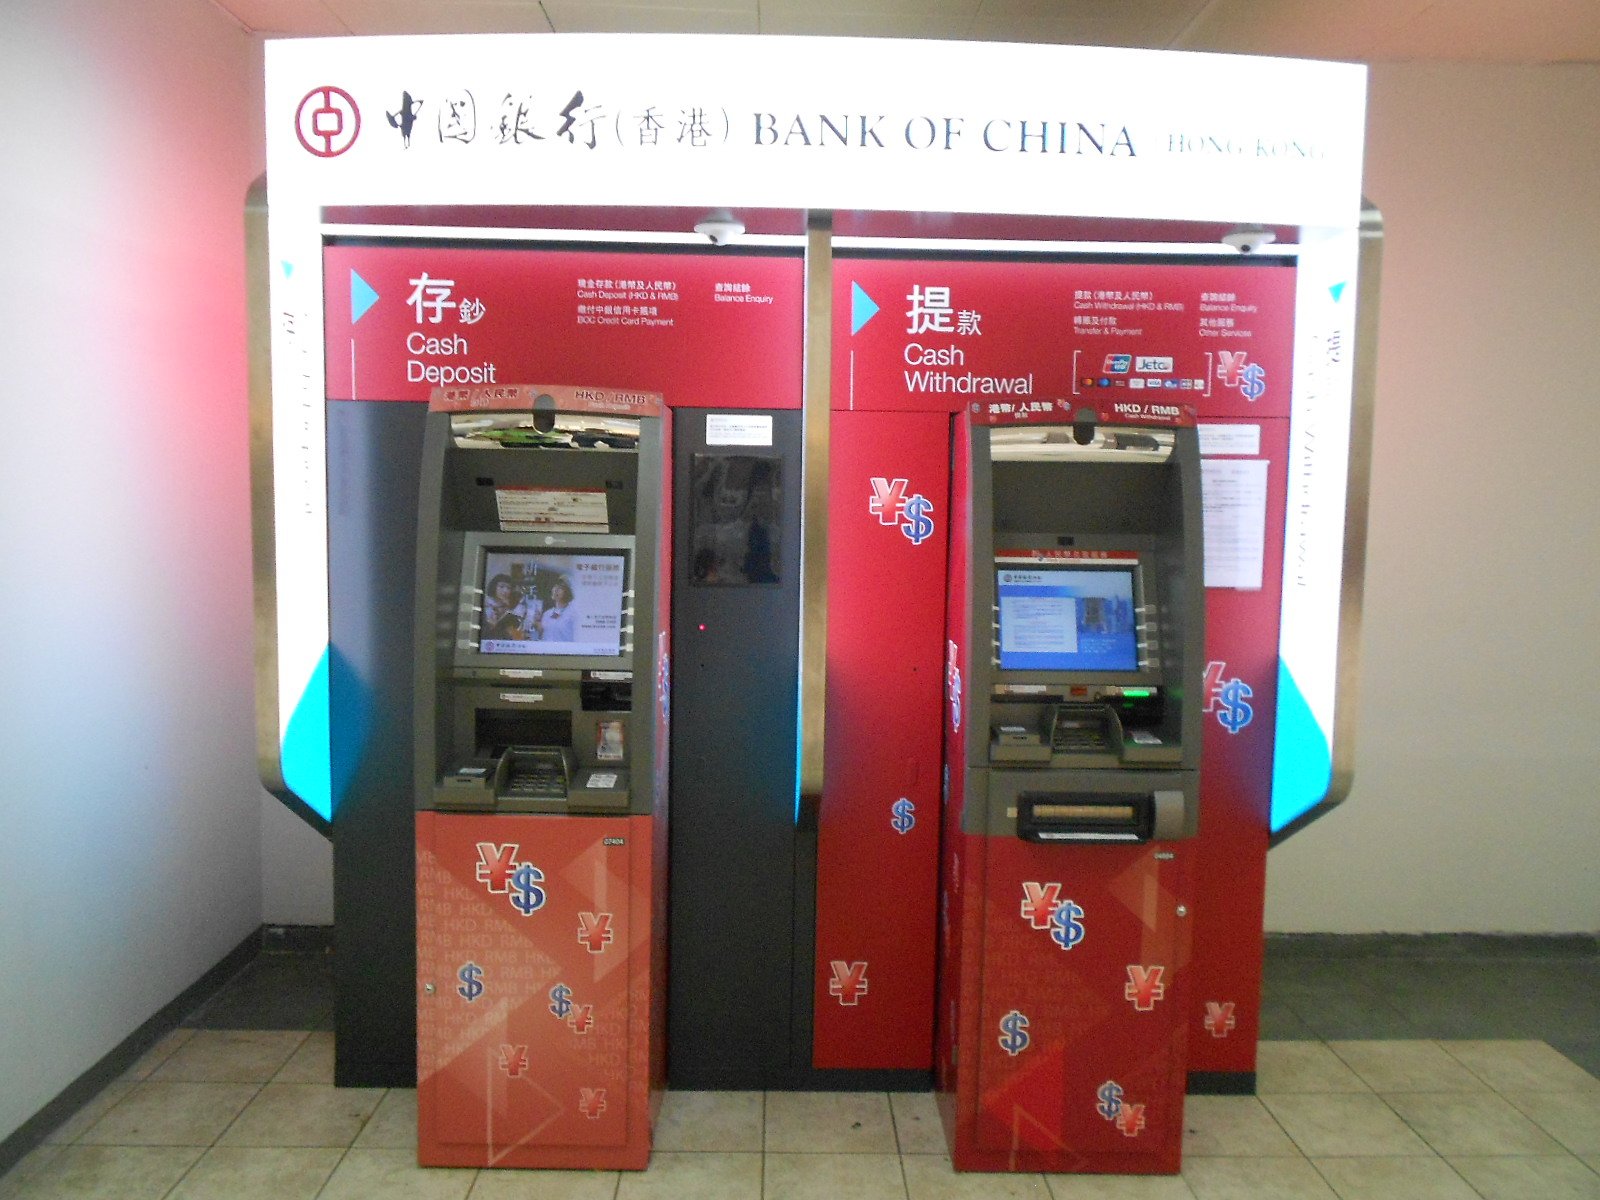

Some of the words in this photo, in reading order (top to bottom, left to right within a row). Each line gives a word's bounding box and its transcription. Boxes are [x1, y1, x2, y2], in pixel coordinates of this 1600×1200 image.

[752, 113, 886, 148] BANK
[904, 116, 964, 151] OF
[983, 119, 1138, 158] CHINA
[406, 272, 487, 325] 存鈔
[577, 290, 597, 299] Cash
[714, 293, 744, 303] Balance
[745, 294, 774, 305] Enquiry
[906, 284, 982, 336] 提款
[406, 332, 468, 356] Cash
[903, 343, 964, 366] Cash
[406, 360, 496, 387] Deposit
[903, 371, 1033, 395] Withdrawal
[1114, 403, 1141, 413] HKD
[1151, 405, 1180, 416] RMB
